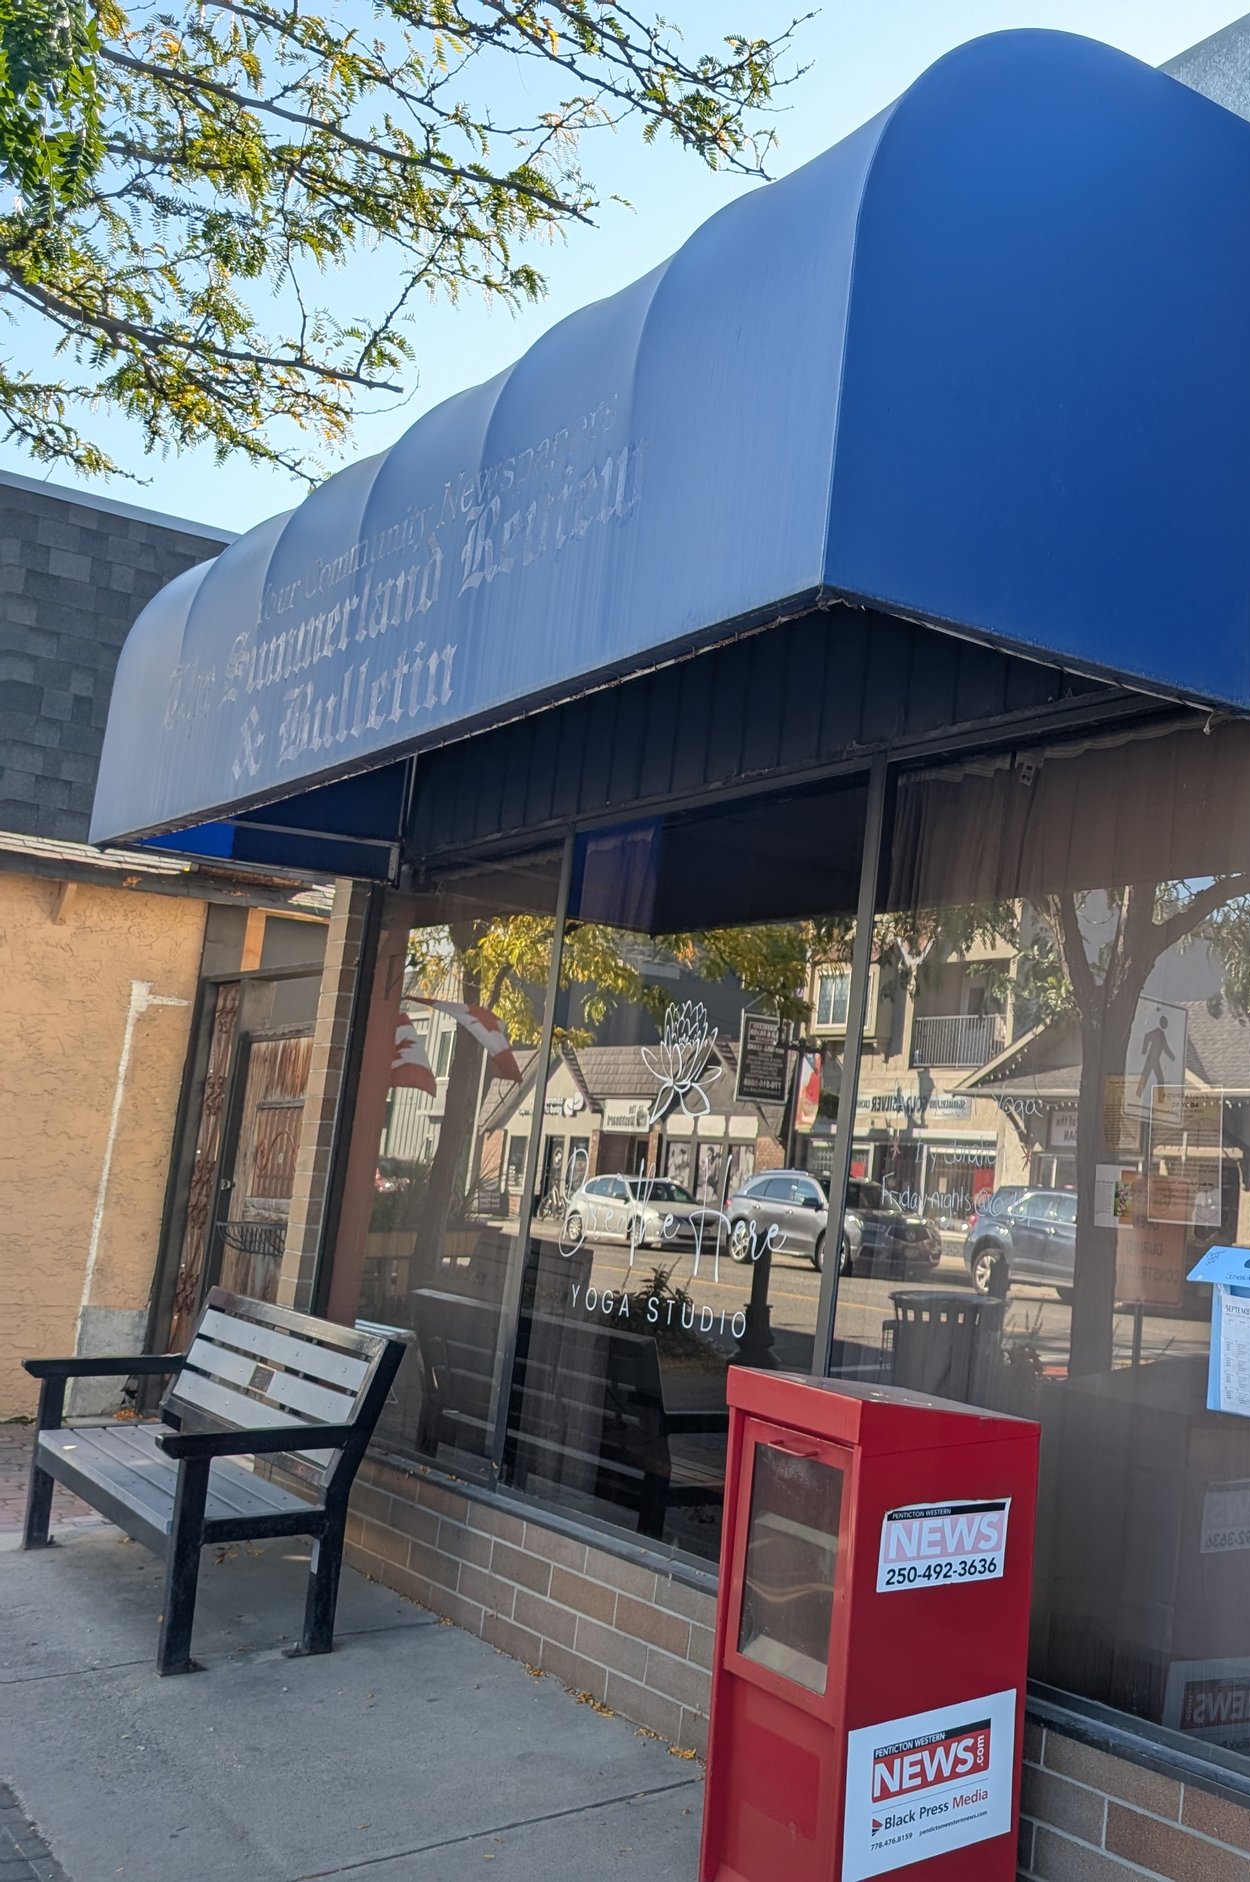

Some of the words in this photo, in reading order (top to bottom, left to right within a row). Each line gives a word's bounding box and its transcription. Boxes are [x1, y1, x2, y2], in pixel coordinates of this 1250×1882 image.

[223, 532, 443, 702] Summerland
[232, 705, 265, 781] &
[278, 640, 458, 768] Bulletin
[989, 1089, 1044, 1133] Yoga
[881, 1172, 927, 1219] Friday
[930, 1186, 972, 1227] nights
[571, 1284, 630, 1319] YOGA
[646, 1297, 746, 1339] STUDIO
[888, 1513, 1000, 1559] NEWS
[892, 1510, 924, 1520] PENTICTON
[925, 1508, 951, 1517] WESTERN
[885, 1557, 997, 1586] 250-492-3636
[873, 1738, 975, 1798] NEWS
[977, 1735, 985, 1767] .com
[875, 1741, 913, 1758] PENTICTON
[914, 1732, 946, 1747] WESTERN
[884, 1810, 915, 1830] Black
[919, 1802, 949, 1819] Press
[952, 1789, 988, 1809] Media
[919, 1810, 988, 1837] pentictonwesternnews.com
